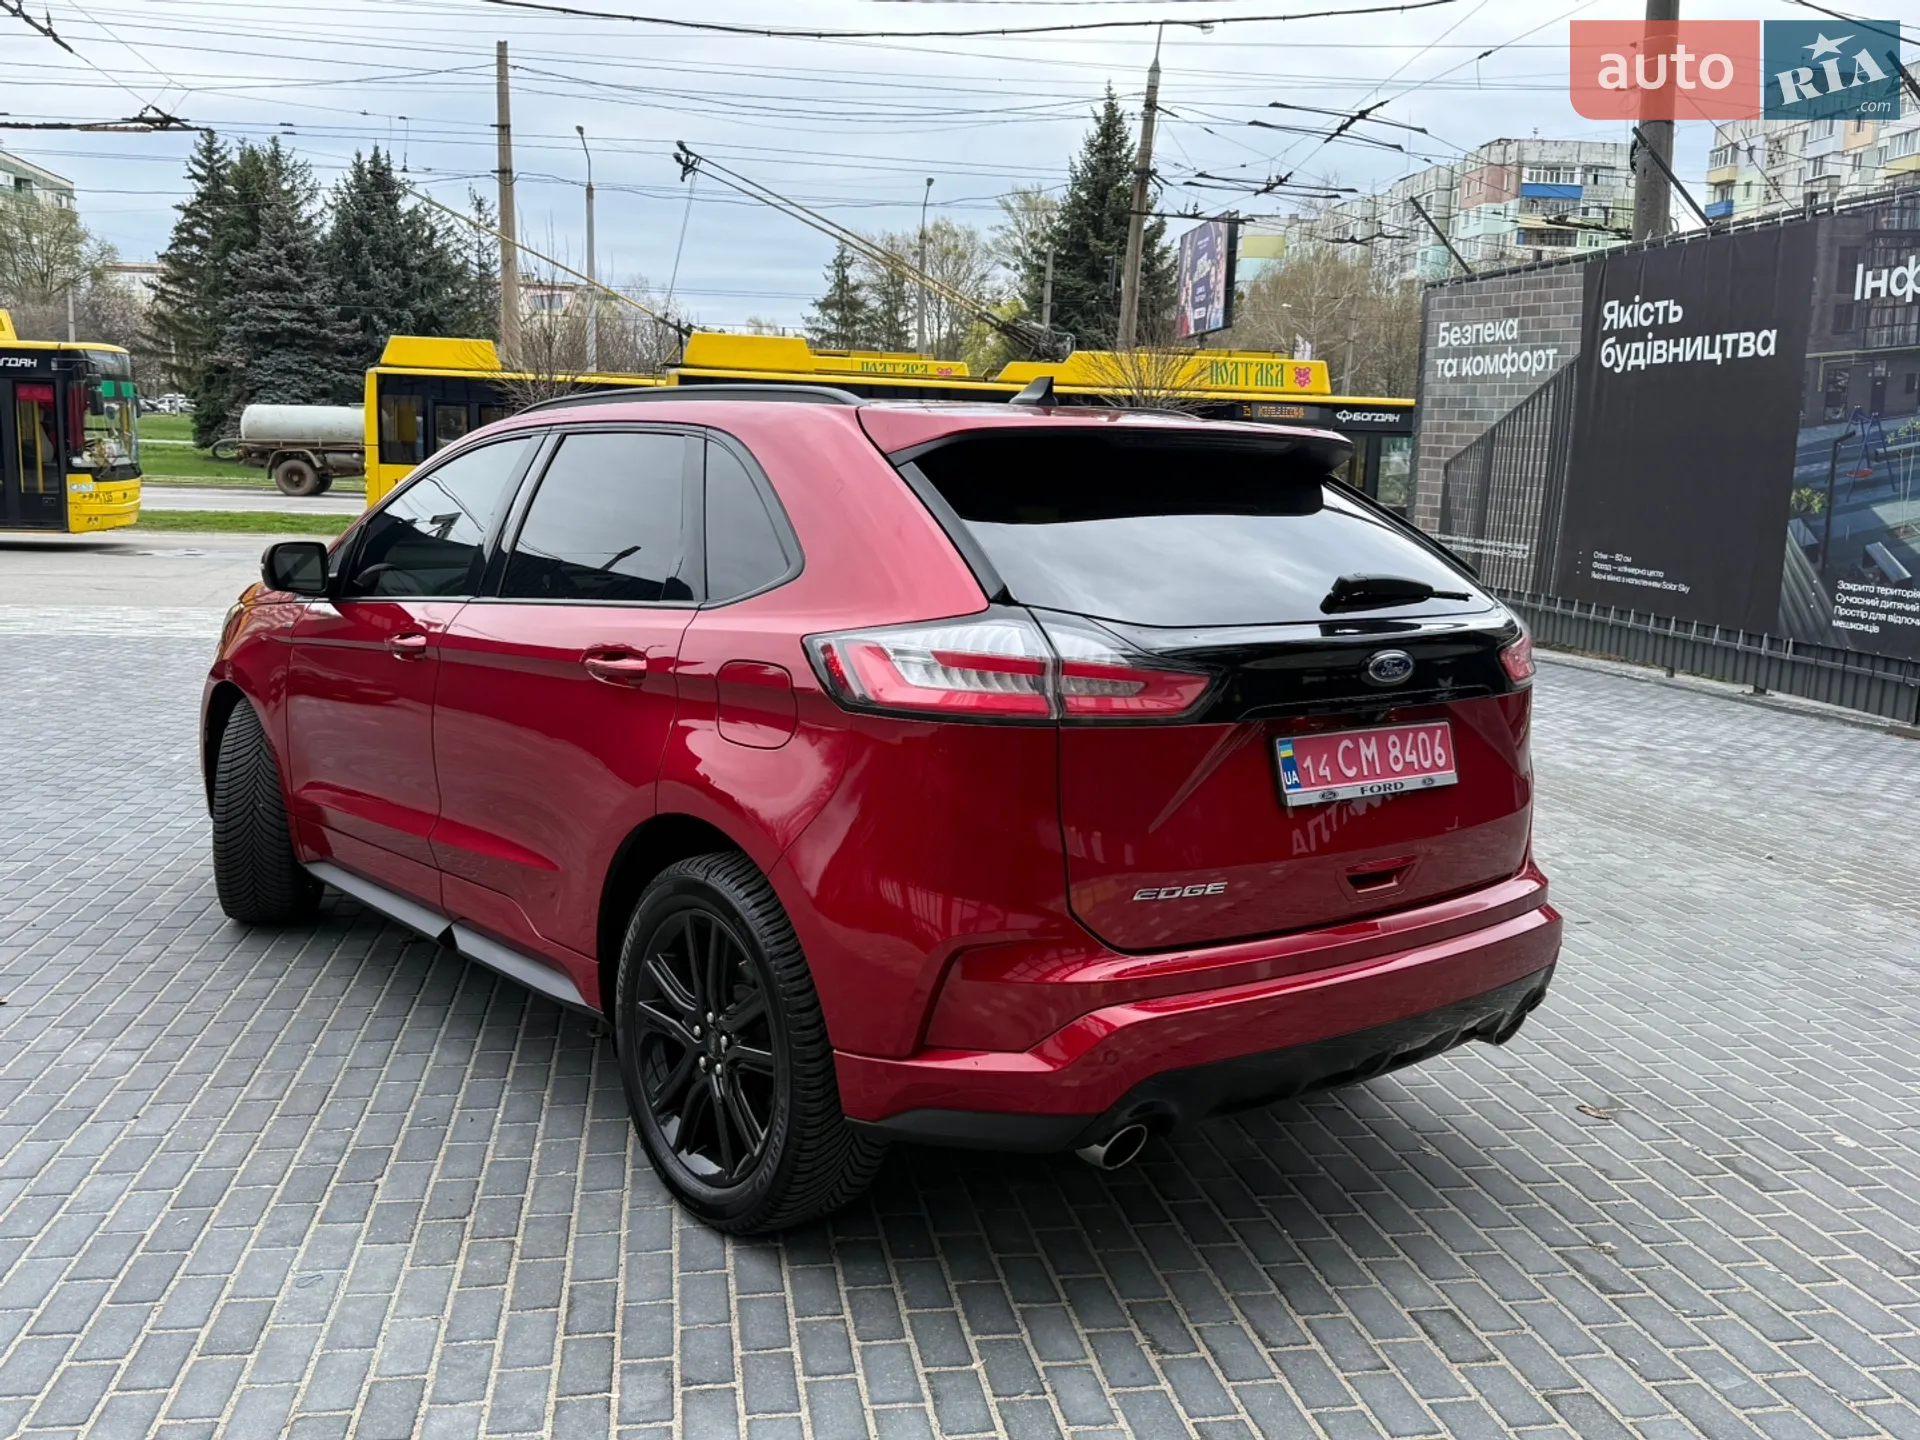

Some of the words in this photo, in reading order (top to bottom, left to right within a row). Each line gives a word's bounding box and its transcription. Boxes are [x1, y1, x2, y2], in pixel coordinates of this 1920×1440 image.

[1603, 295, 1683, 330] Якість
[1438, 318, 1518, 348] Безпека
[1601, 329, 1777, 373] будівництва
[1436, 357, 1457, 378] та
[1461, 346, 1558, 378] комфорт
[1209, 360, 1285, 387] ПОЛТАВА
[1352, 412, 1400, 422] БОГДАН
[1837, 580, 1874, 593] Закрита
[1836, 593, 1879, 606] Сучасний
[1879, 600, 1919, 613] дитячий
[1833, 605, 1868, 619] Простір
[1868, 611, 1886, 621] для
[1832, 619, 1879, 633] мешканців
[1381, 660, 1408, 676] Ford
[1303, 753, 1331, 784] 14
[1337, 736, 1381, 778] CM
[1388, 729, 1446, 772] 8406
[1284, 771, 1299, 785] UA
[1361, 781, 1404, 795] FORD
[1132, 882, 1228, 900] EDGE
